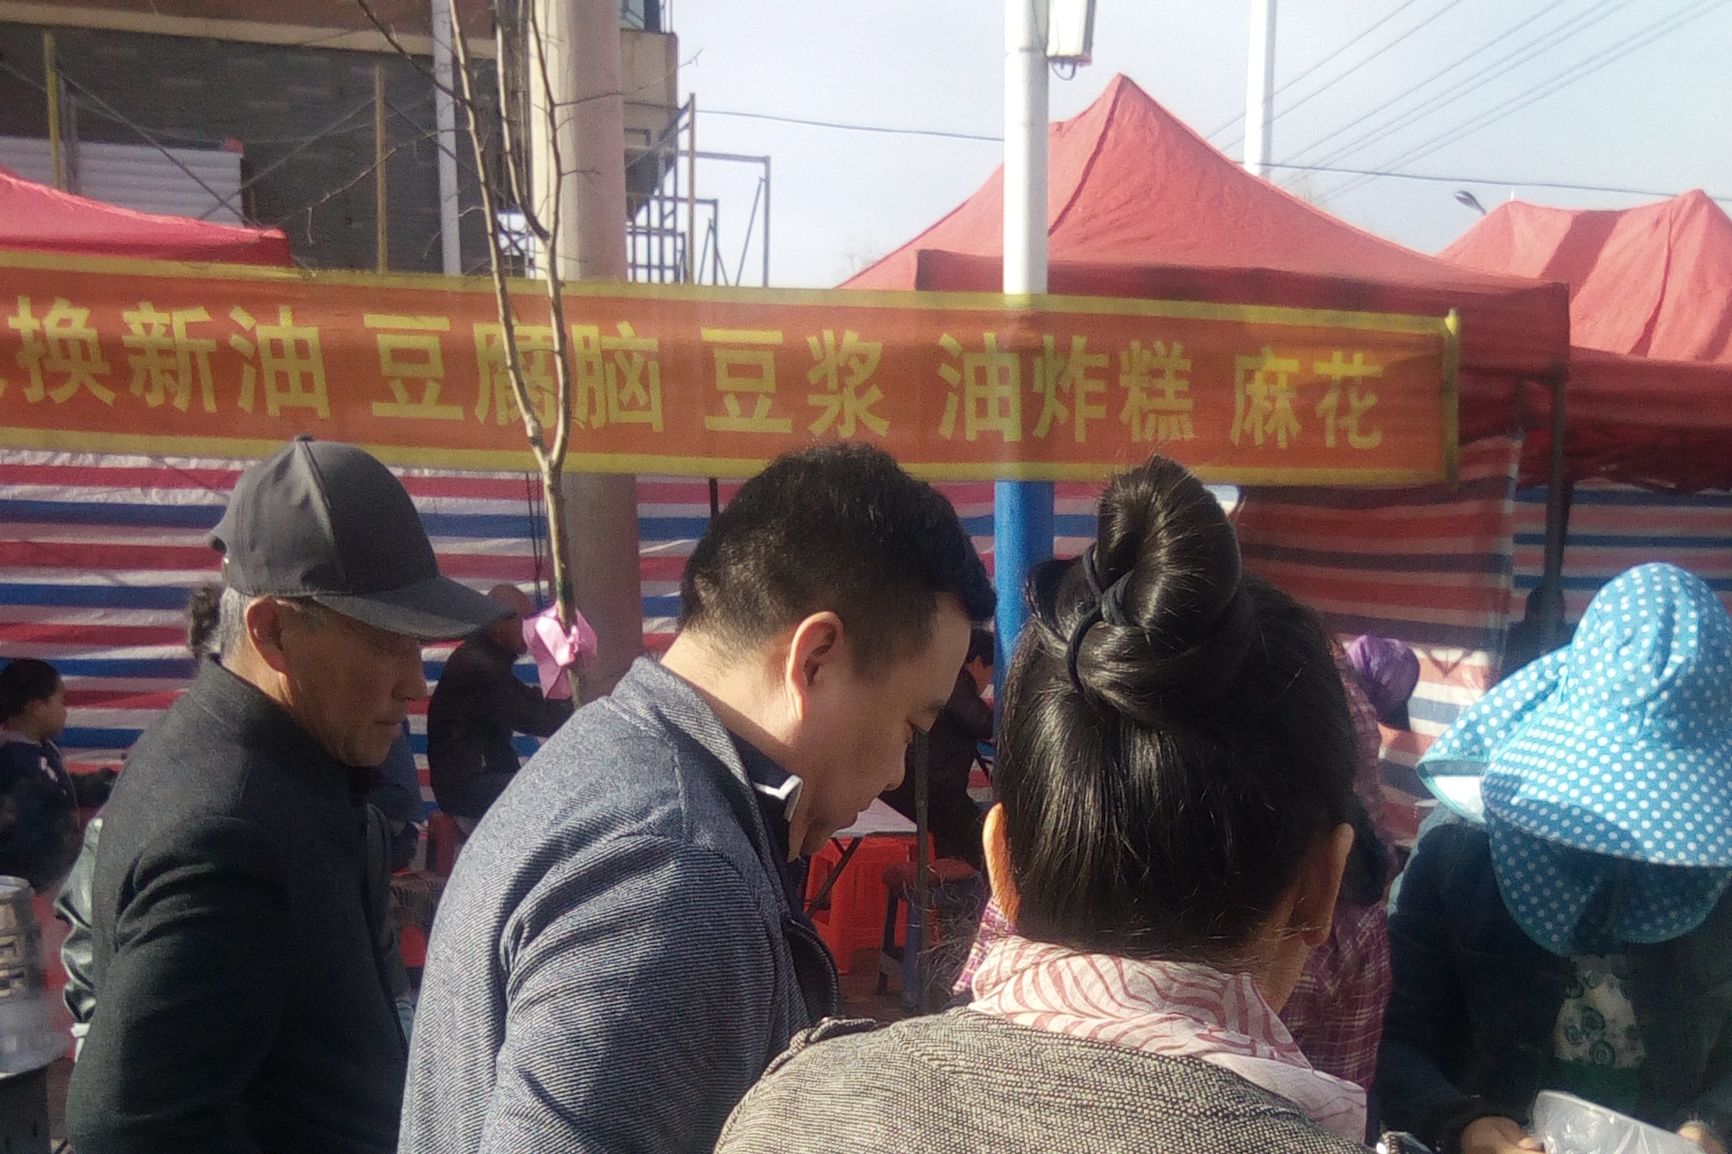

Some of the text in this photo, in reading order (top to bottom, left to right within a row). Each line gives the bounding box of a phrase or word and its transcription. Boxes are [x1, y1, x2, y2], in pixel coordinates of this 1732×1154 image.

[0, 295, 1385, 449] 换新油 豆腐脑 豆浆 油炸糕 麻花
